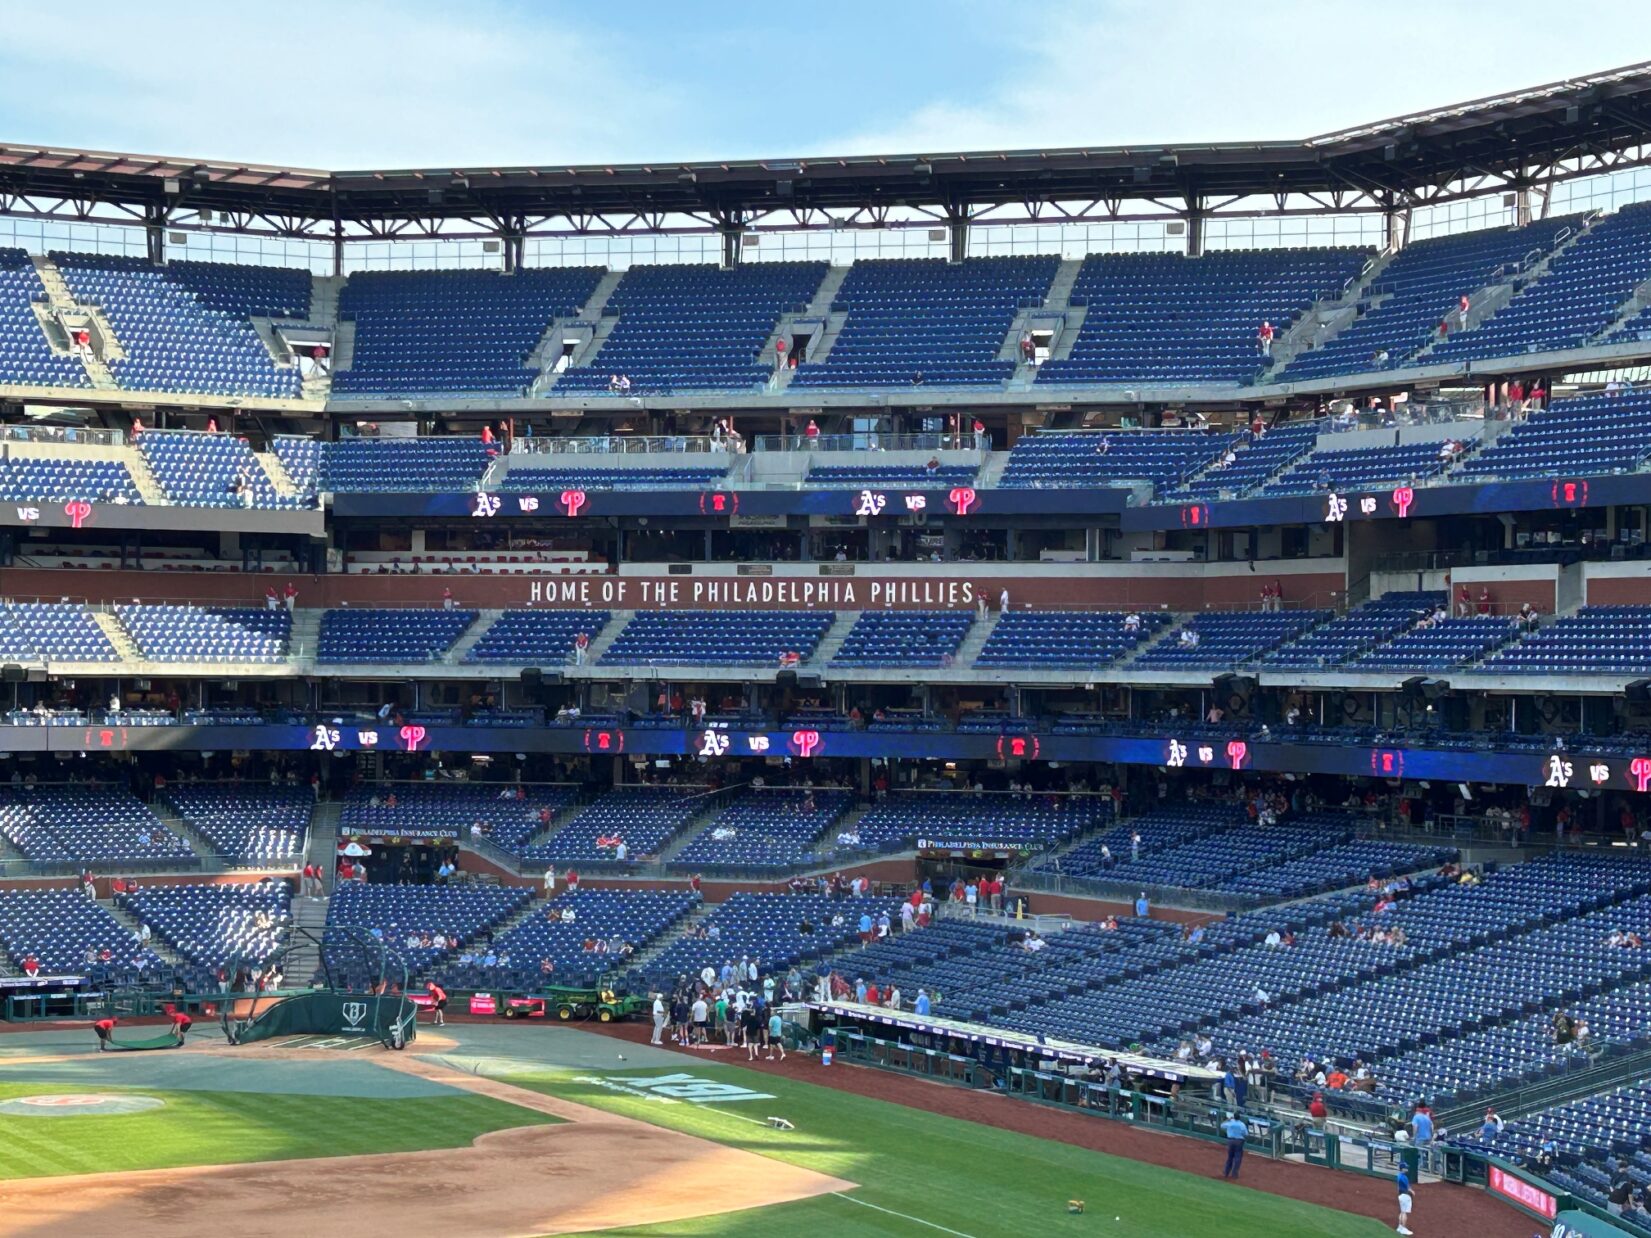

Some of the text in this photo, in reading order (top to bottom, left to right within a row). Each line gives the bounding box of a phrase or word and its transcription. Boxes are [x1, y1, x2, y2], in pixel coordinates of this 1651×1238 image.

[64, 500, 91, 528] P
[560, 490, 586, 516] P
[949, 488, 976, 515] P
[1392, 488, 1413, 517] P
[530, 581, 974, 604] HOME OF THE PHILADELPHIA PHILLIES
[400, 726, 426, 751] P
[793, 730, 819, 757] P
[1227, 741, 1247, 769] P
[1630, 757, 1651, 792] P
